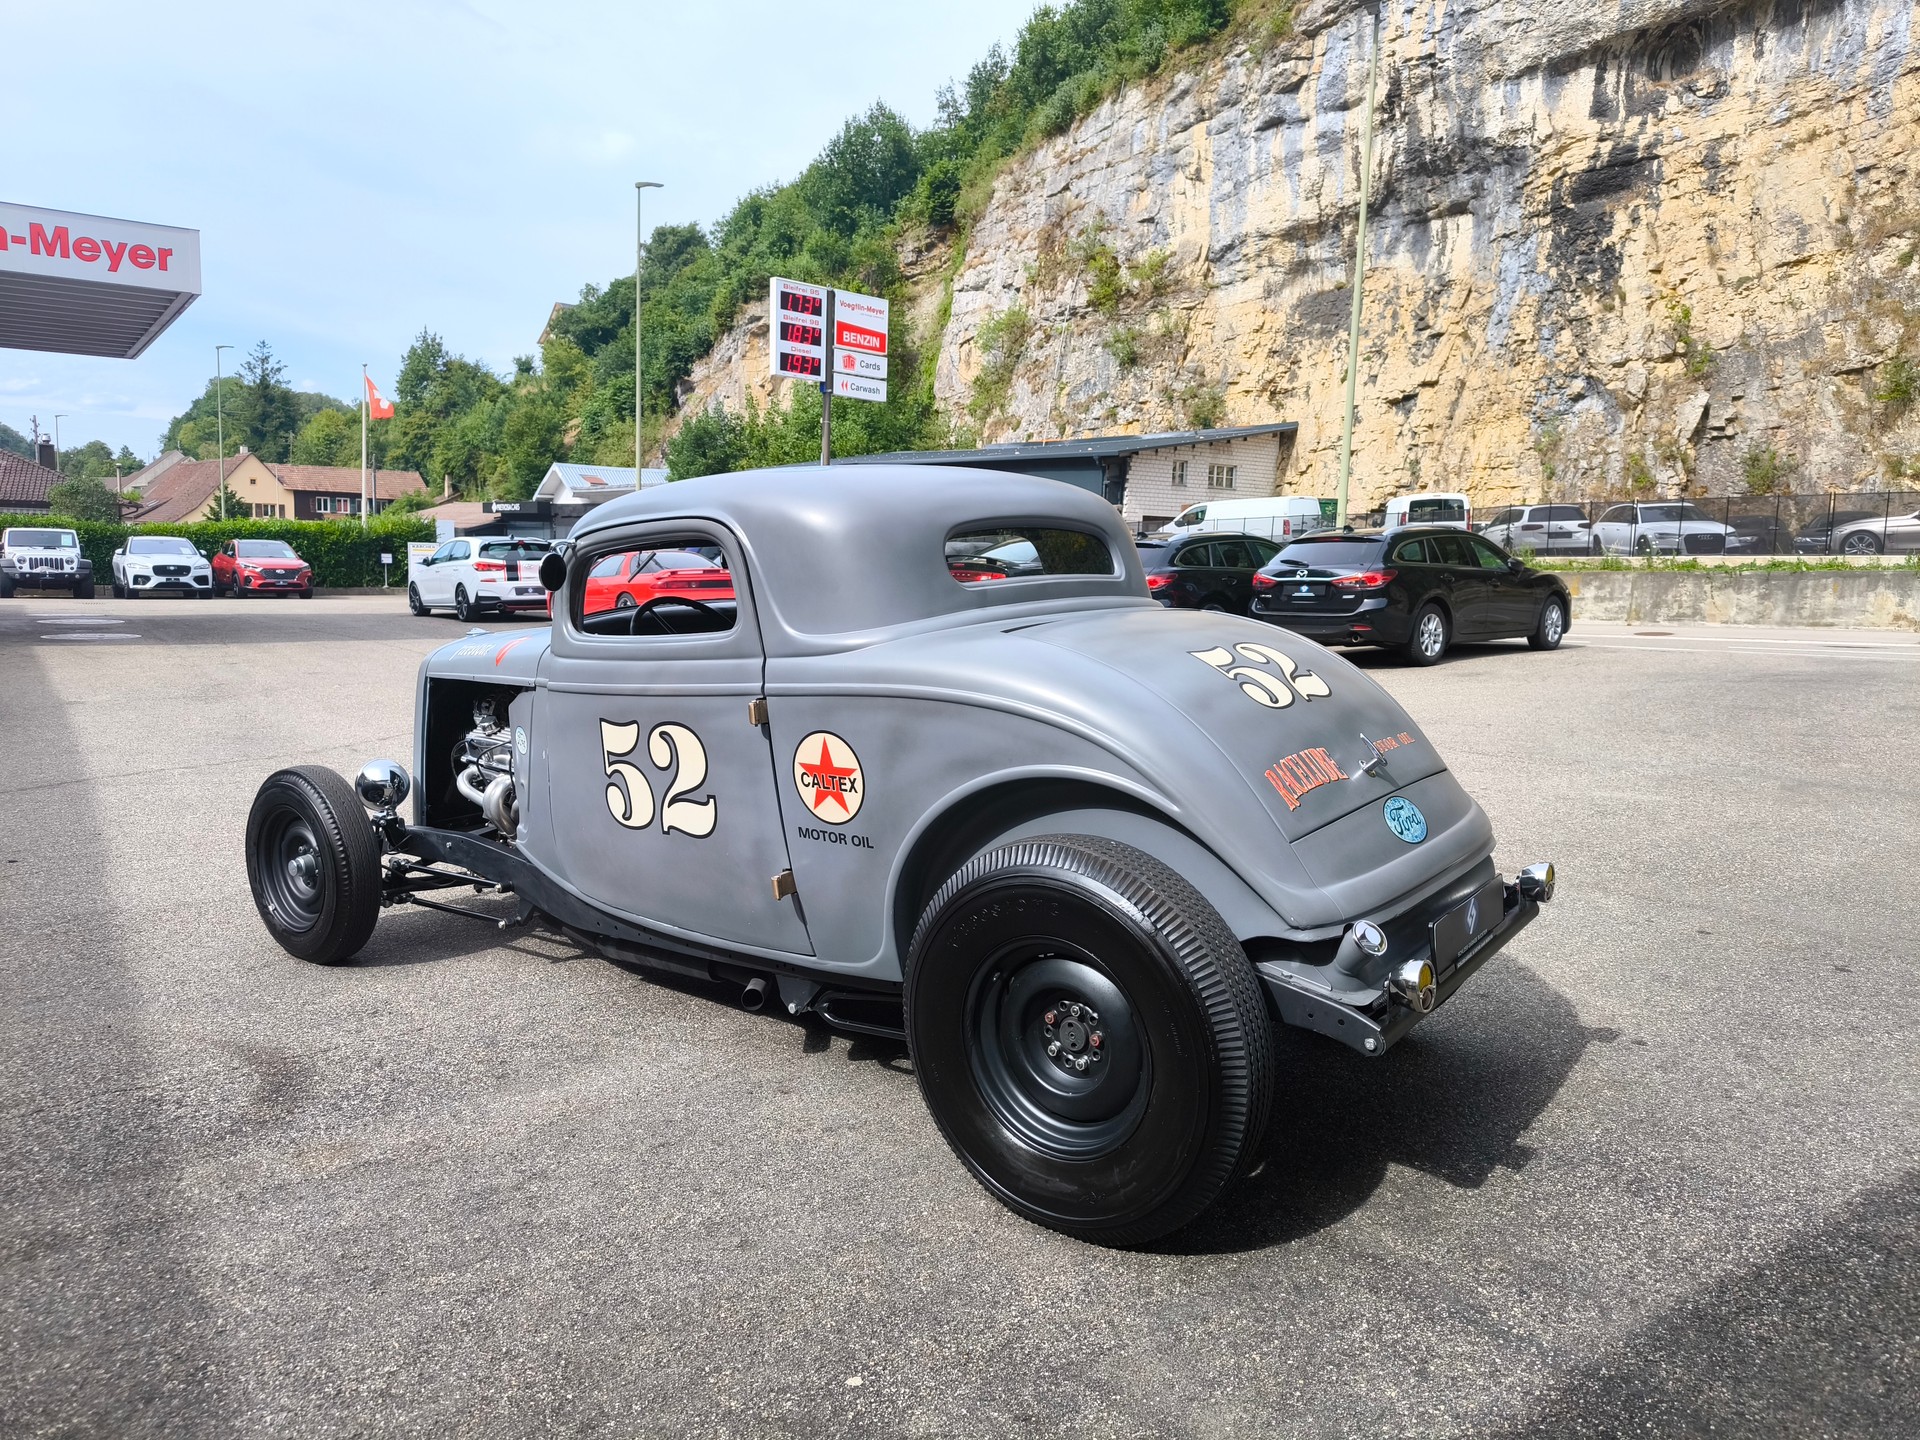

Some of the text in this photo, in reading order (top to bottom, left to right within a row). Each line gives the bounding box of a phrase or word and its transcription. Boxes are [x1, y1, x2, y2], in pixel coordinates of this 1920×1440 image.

[783, 283, 808, 293] Bleifrei
[783, 314, 808, 324] Bleifrei
[843, 331, 880, 348] BENZIN
[791, 346, 812, 354] Diesel
[859, 359, 881, 371] Cards
[850, 382, 881, 395] Carwash
[1187, 642, 1332, 709] 52
[1397, 732, 1416, 745] OIL
[599, 717, 718, 839] 52
[800, 771, 858, 794] CALTEX
[1264, 747, 1350, 812] RACELUBE
[1389, 804, 1422, 836] Ford
[797, 826, 874, 849] MOTOR OIL
